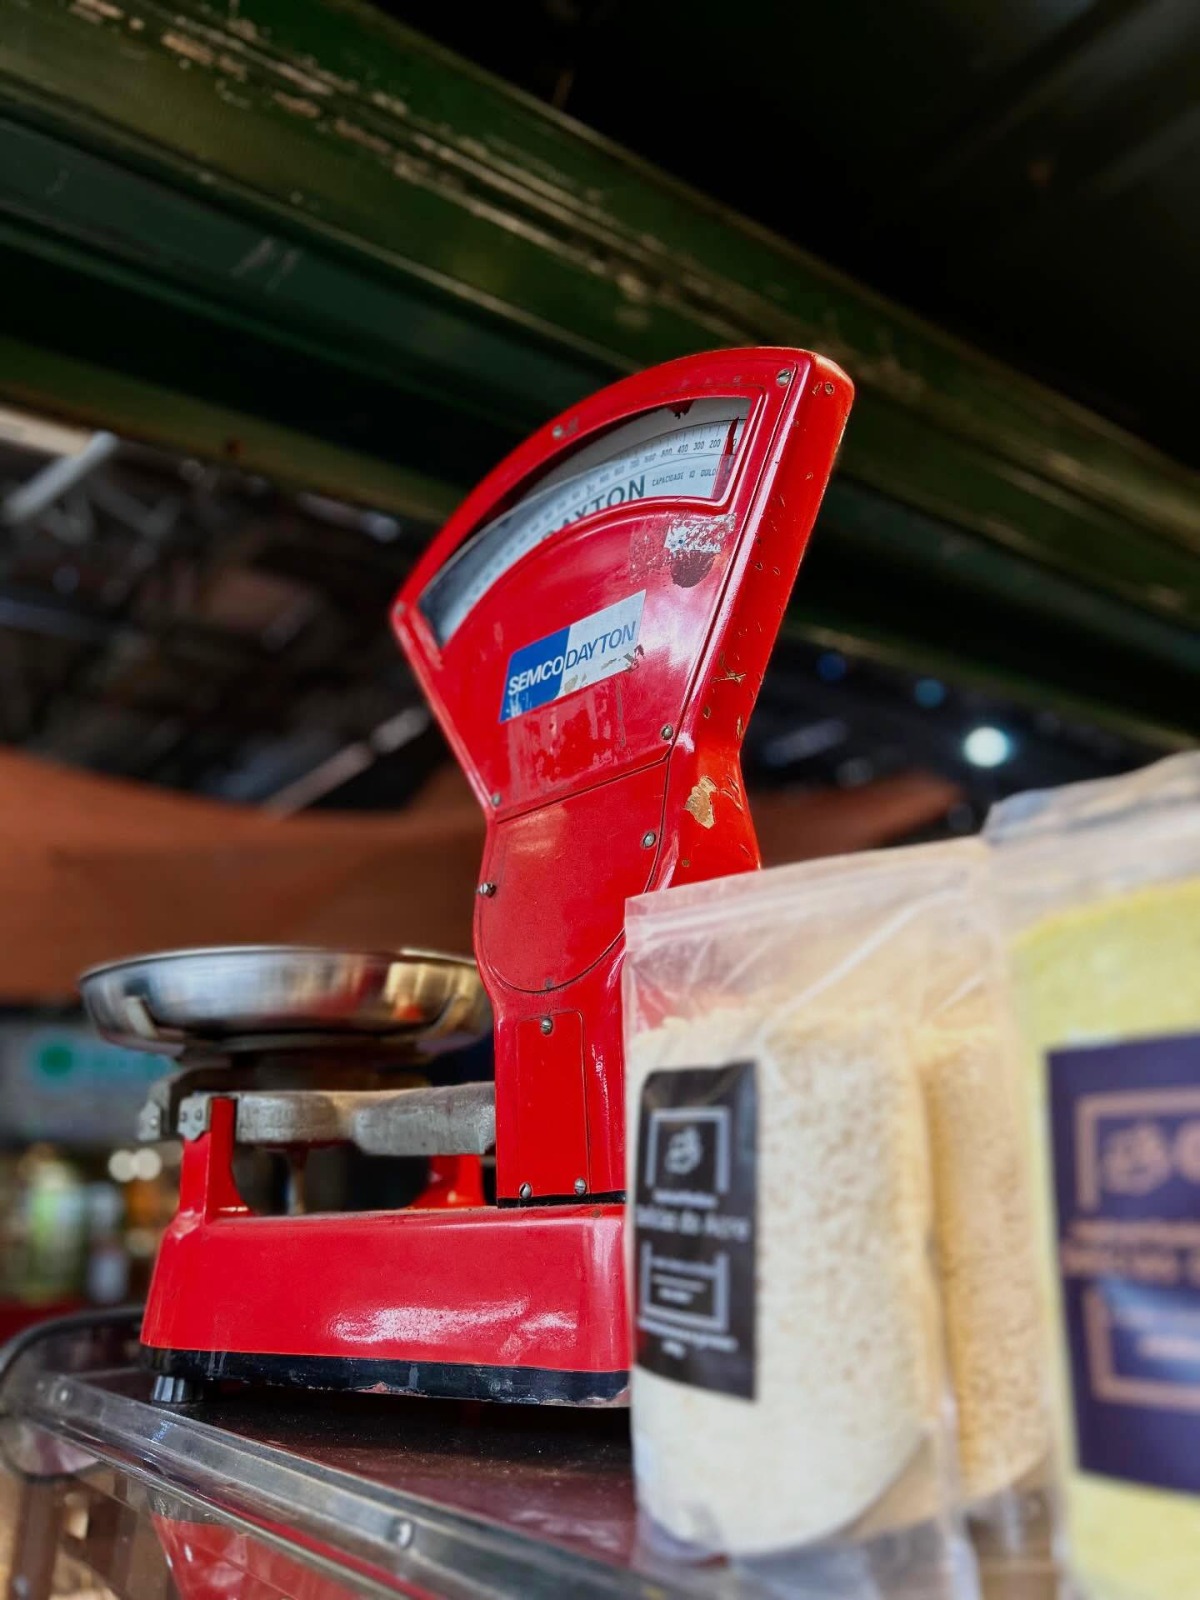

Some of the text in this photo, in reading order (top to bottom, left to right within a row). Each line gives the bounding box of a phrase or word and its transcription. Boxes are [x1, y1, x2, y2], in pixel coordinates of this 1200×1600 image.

[677, 444, 689, 454] 400
[693, 441, 705, 450] 300
[709, 439, 721, 449] 200
[508, 621, 636, 696] SEMCO DAYTON
